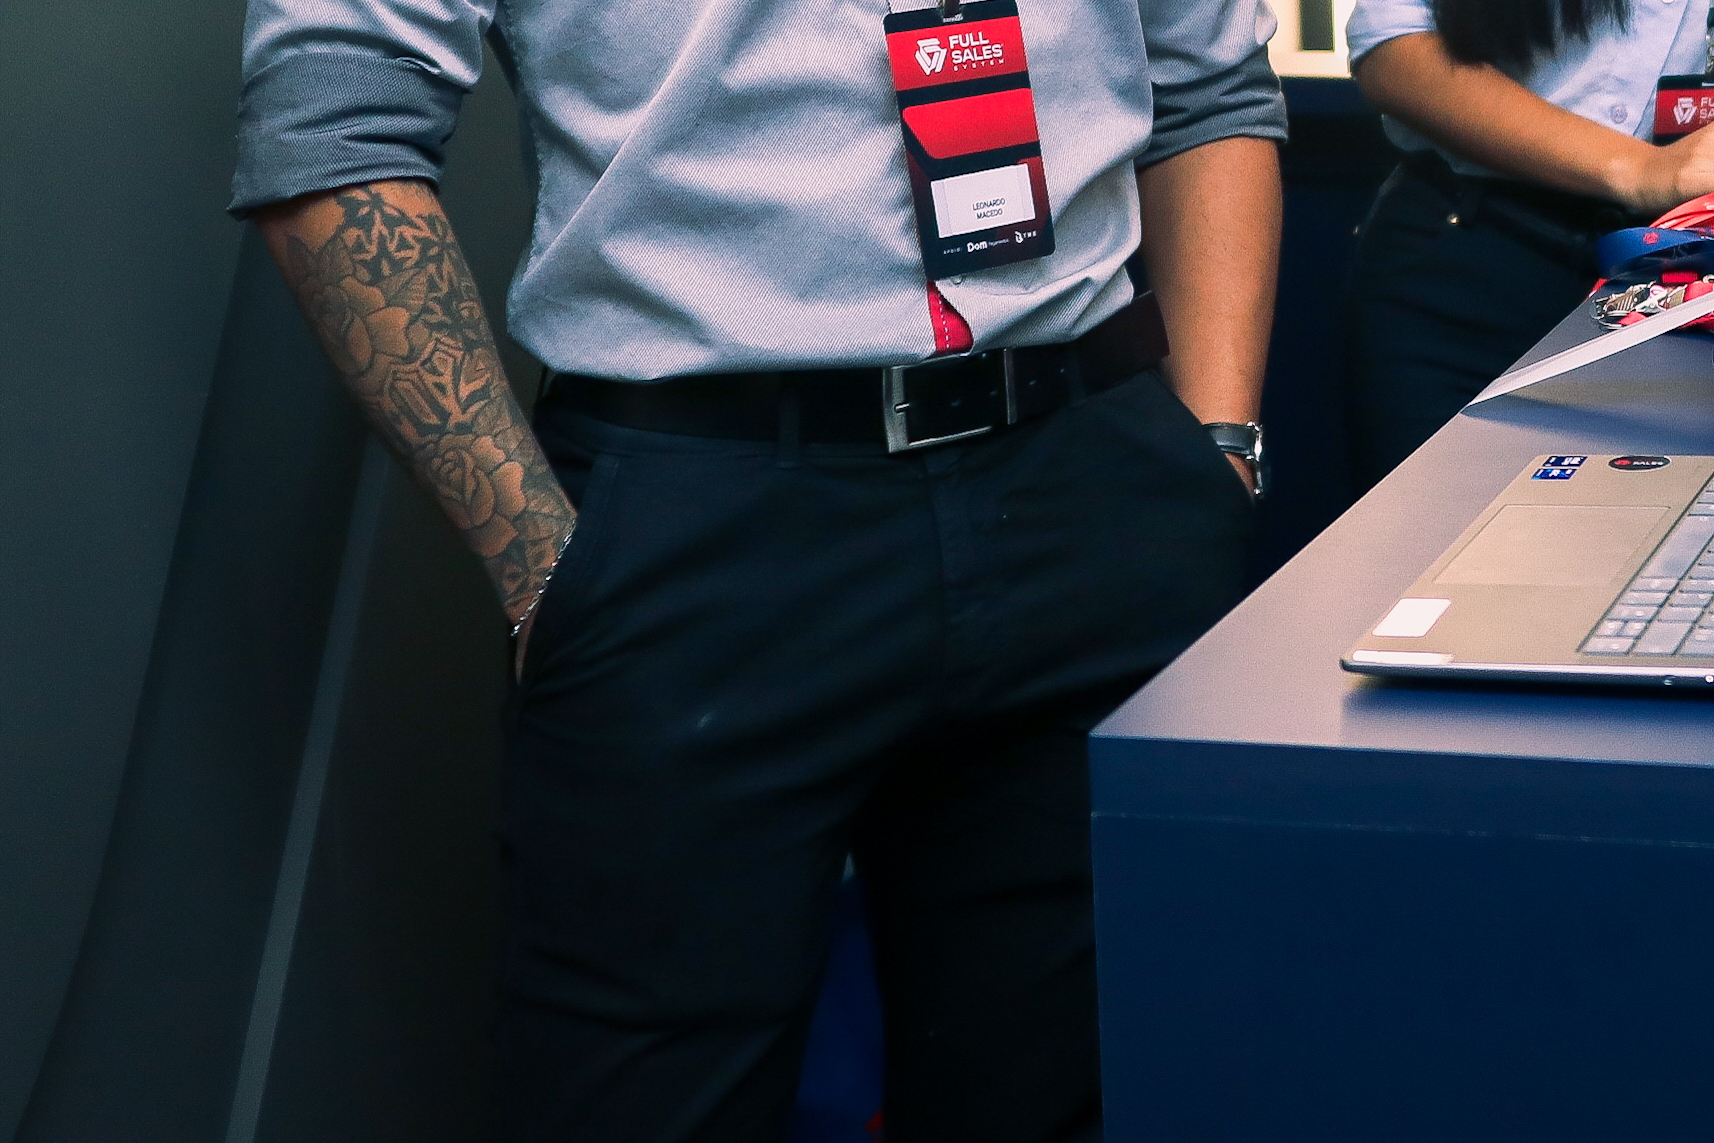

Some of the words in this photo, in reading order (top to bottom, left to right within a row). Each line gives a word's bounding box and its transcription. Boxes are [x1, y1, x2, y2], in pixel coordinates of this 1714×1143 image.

[949, 31, 989, 49] FULL
[951, 43, 1003, 64] SALES
[953, 58, 1005, 71] SYSTEM
[972, 198, 1006, 211] LEONARDO
[976, 208, 1003, 220] MACEDO
[966, 240, 988, 253] Dom
